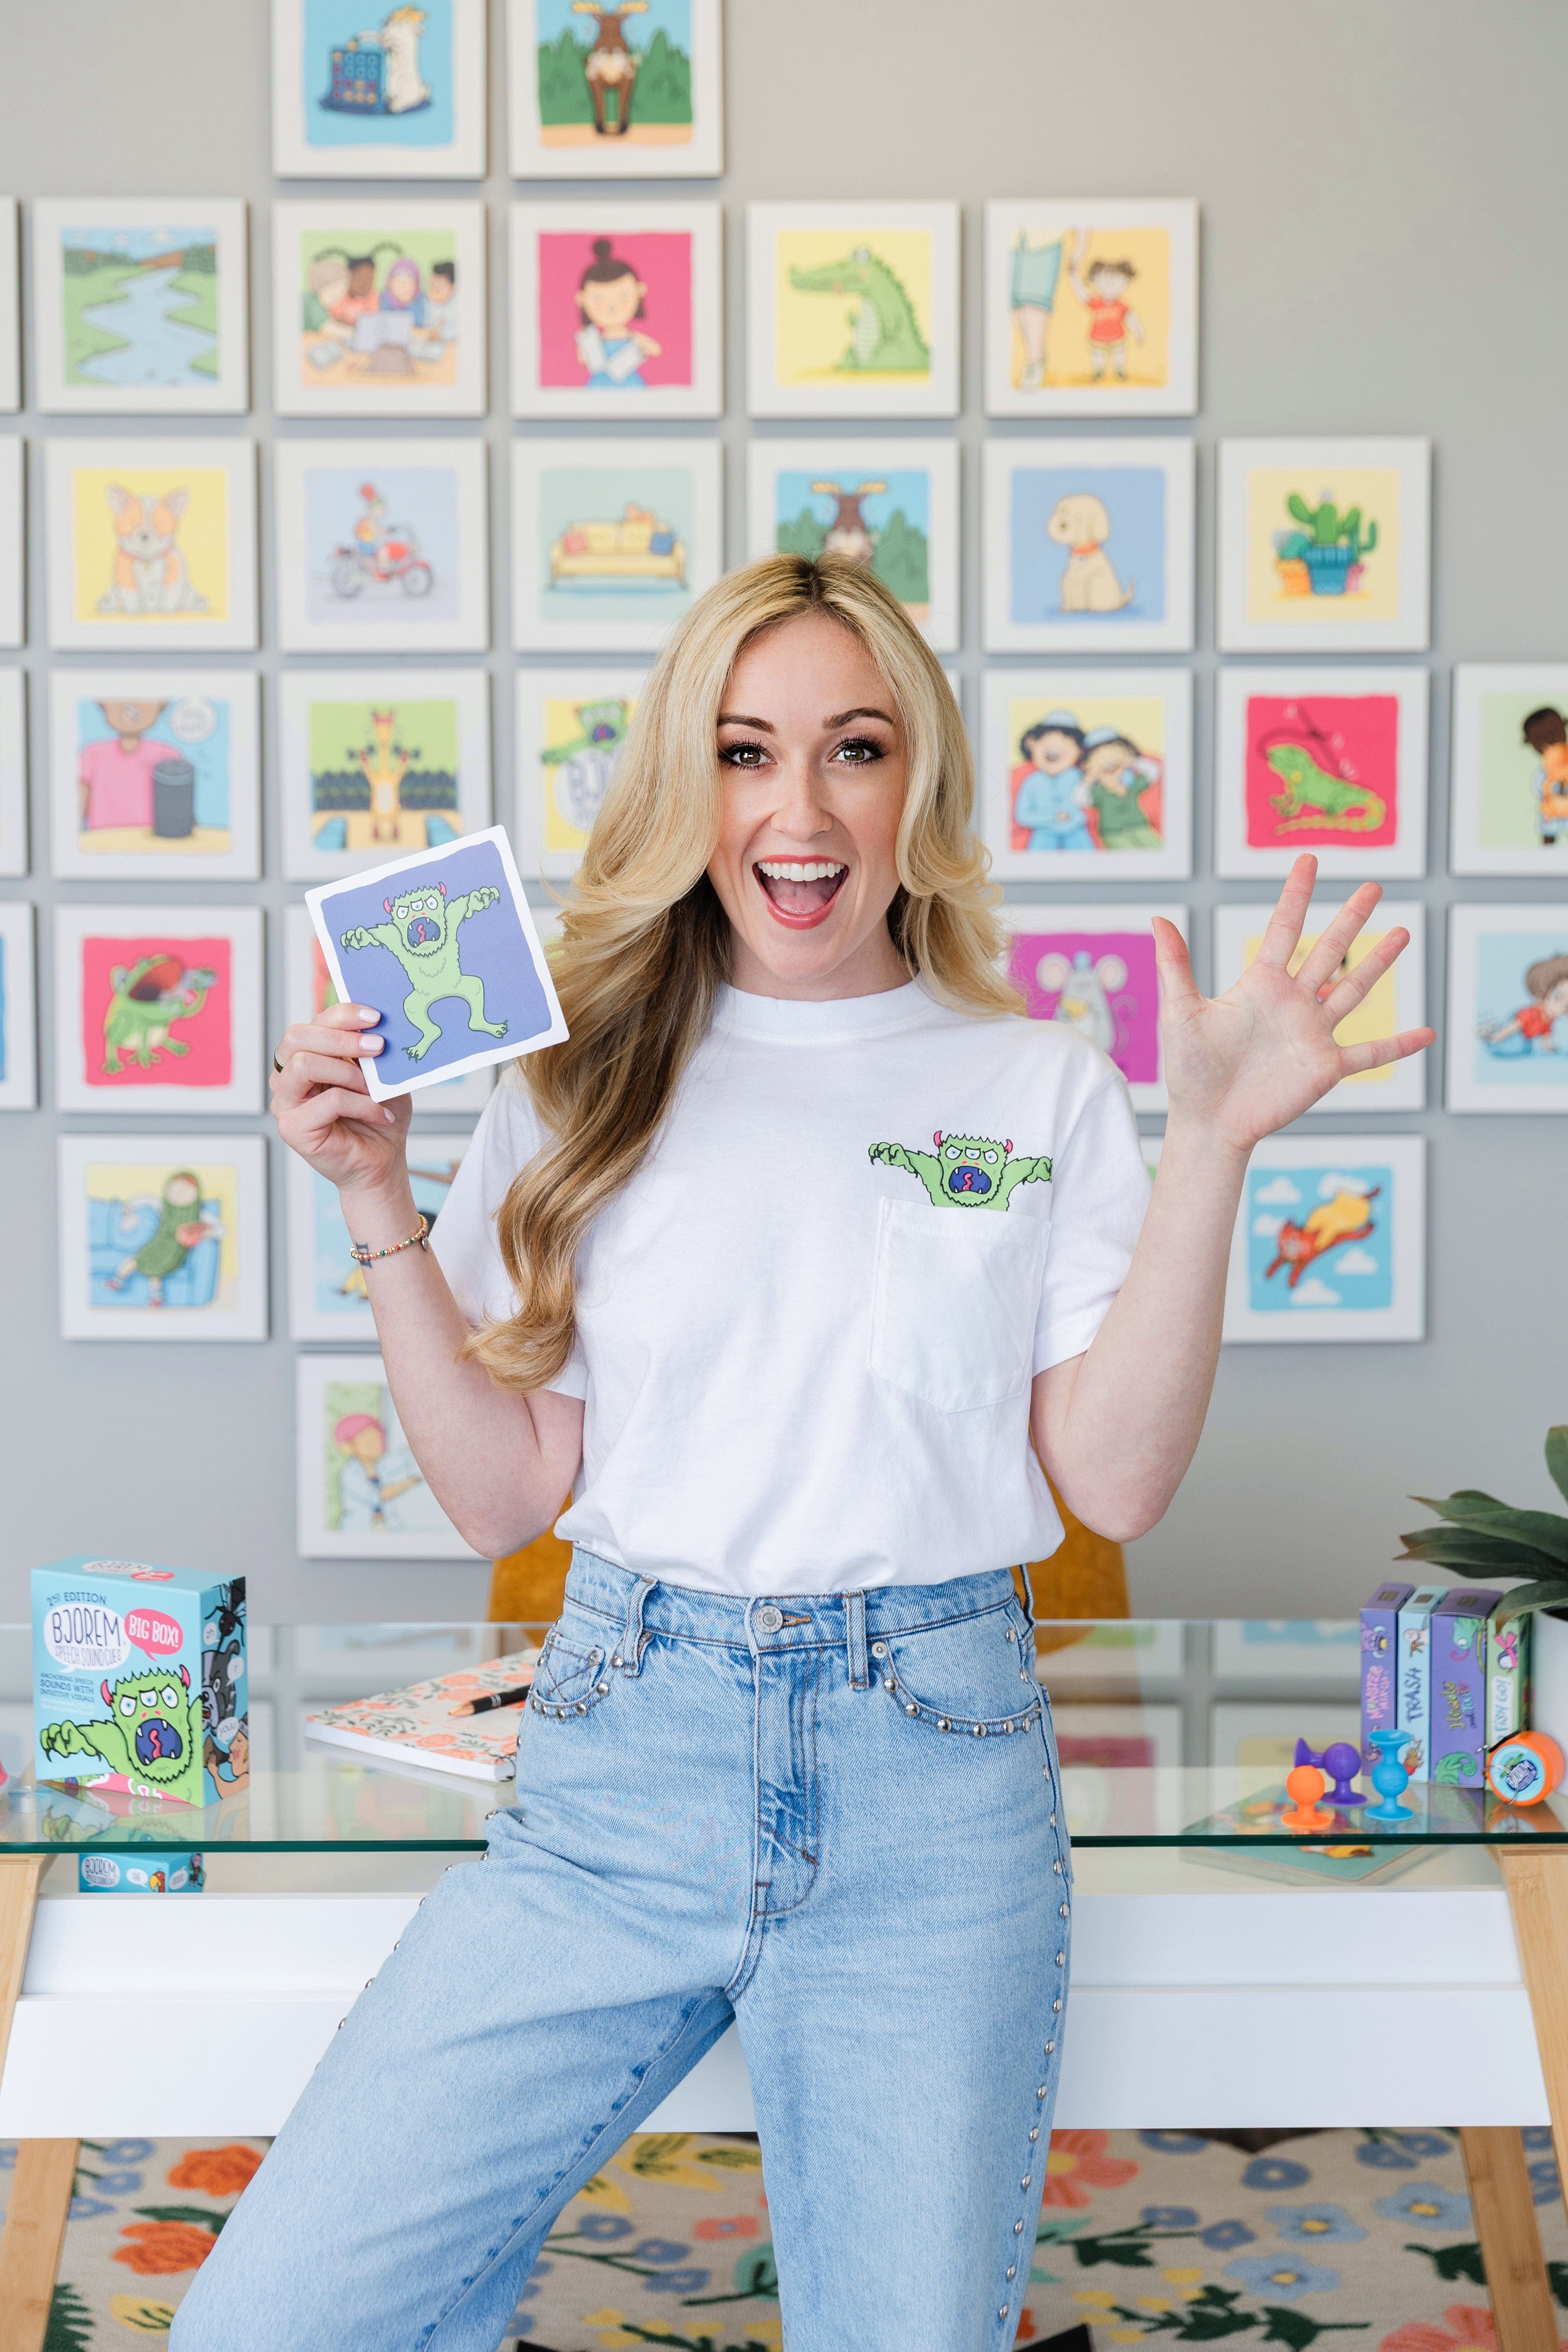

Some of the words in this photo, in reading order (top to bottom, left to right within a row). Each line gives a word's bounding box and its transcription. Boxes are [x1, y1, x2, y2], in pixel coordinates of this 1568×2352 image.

[64, 1591, 107, 1606] EDITION
[52, 1607, 120, 1647] BJOREM
[129, 1614, 150, 1640] BIG
[151, 1620, 179, 1648] BOX!
[40, 1679, 71, 1691] SOUNDS
[1365, 1665, 1384, 1720] MONSTER
[1405, 1667, 1423, 1723] TRASH
[1495, 1679, 1511, 1702] GO!
[1439, 1681, 1466, 1731] Heads
